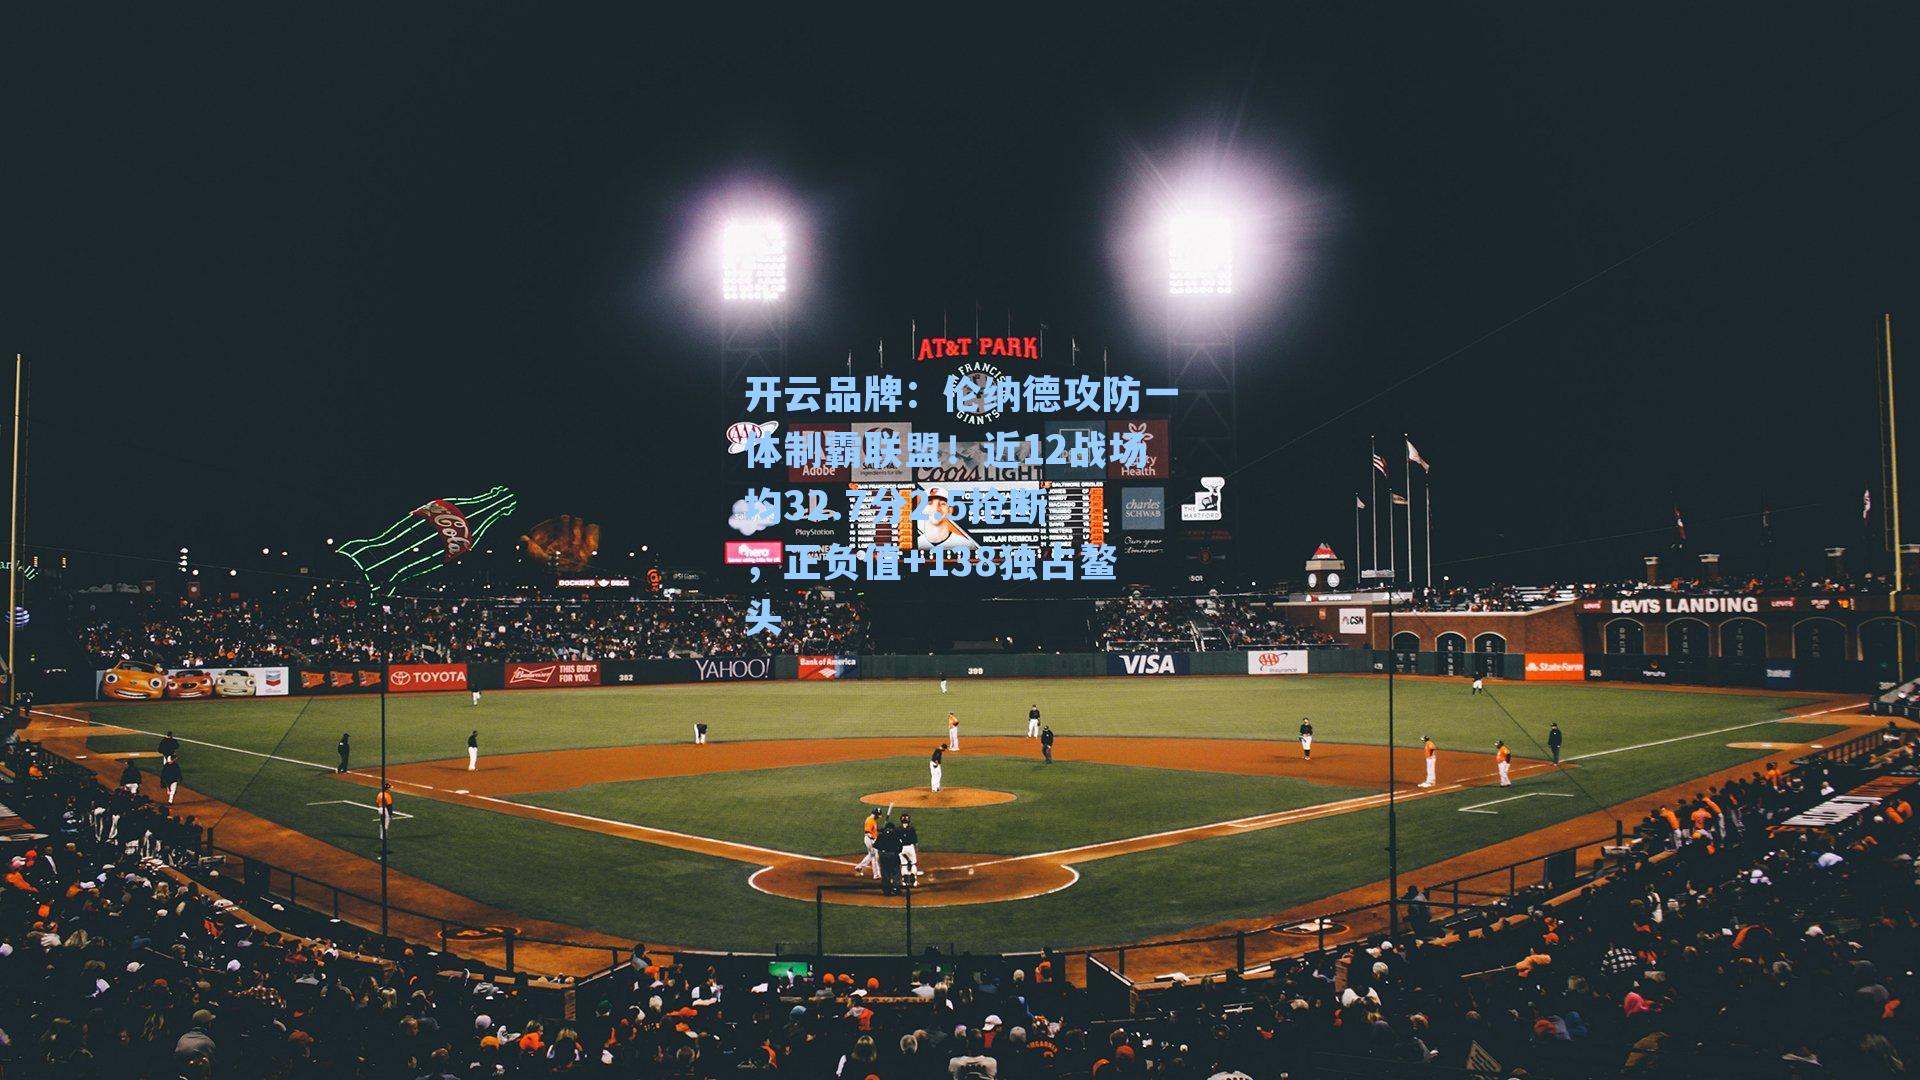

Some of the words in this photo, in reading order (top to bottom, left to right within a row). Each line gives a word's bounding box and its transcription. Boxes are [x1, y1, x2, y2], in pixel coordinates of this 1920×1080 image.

[917, 338, 972, 361] AT&T
[979, 337, 1038, 359] PARK
[956, 410, 1000, 425] GIANTS
[803, 464, 836, 476] Adobe
[917, 464, 982, 481] Coors
[984, 465, 1043, 480] LIGHT
[1121, 467, 1156, 476] Health
[1125, 499, 1160, 509] charles
[1125, 510, 1161, 518] SCHWAB
[795, 528, 835, 537] PlayStation
[1666, 598, 1758, 614] LANDING
[1349, 616, 1364, 625] CSN
[800, 657, 818, 666] Bank
[818, 657, 827, 666] of
[826, 657, 856, 666] America
[1119, 655, 1175, 674] VISA
[559, 665, 575, 673] THIS
[576, 664, 598, 673] BUD'S
[696, 658, 770, 681] YAHOO!
[412, 671, 467, 683] TOYOTA
[515, 671, 551, 679] Budweiser
[559, 674, 573, 682] FOR
